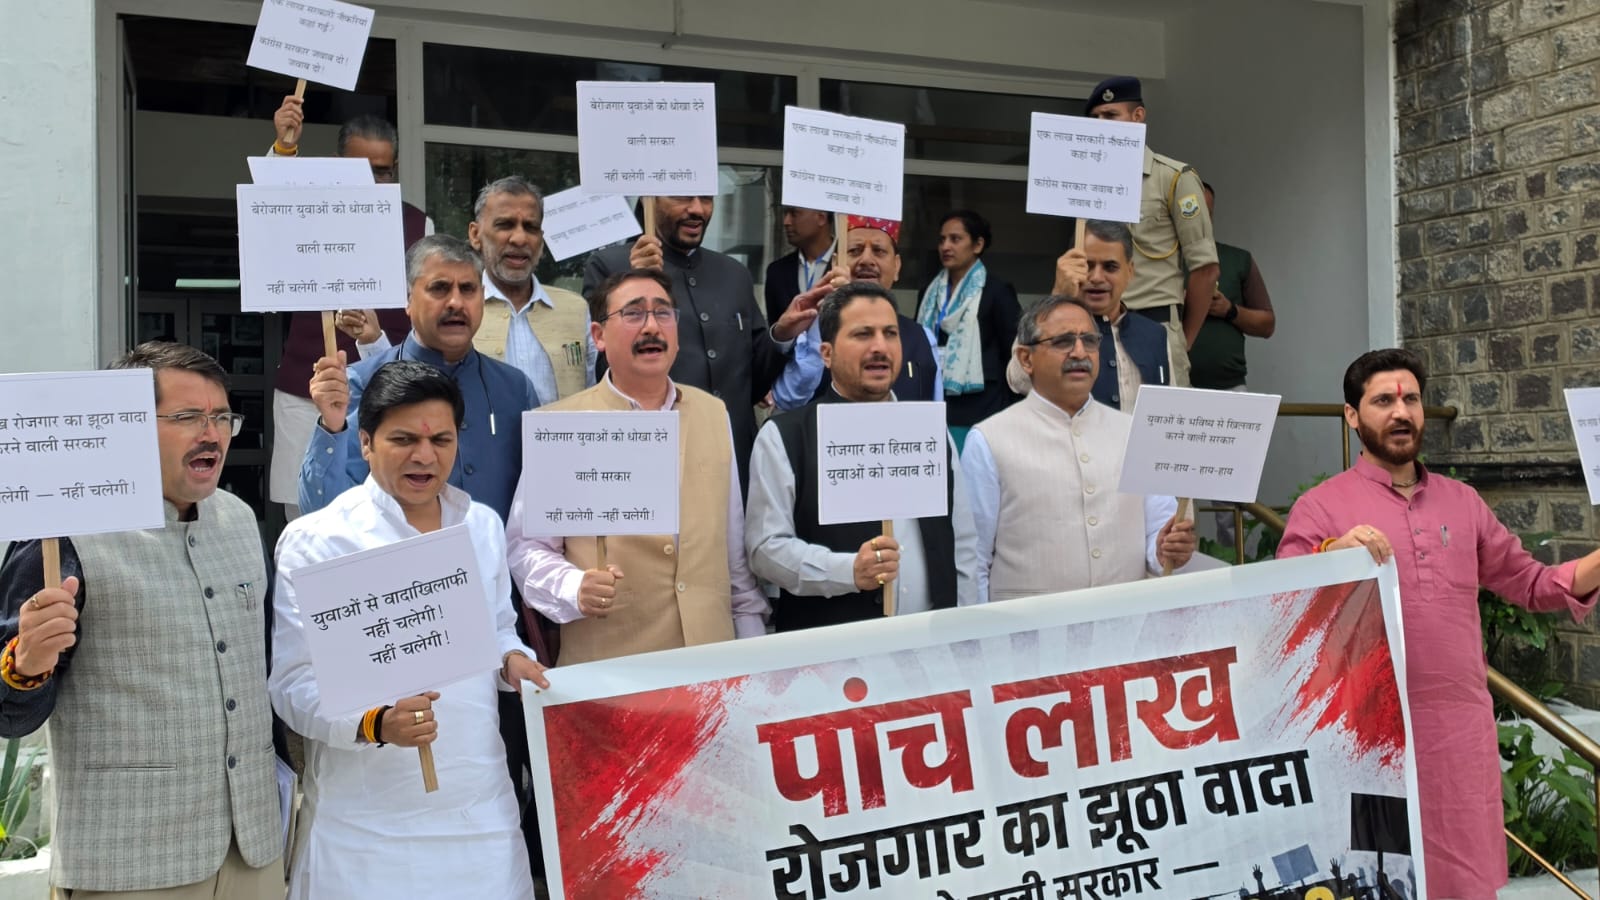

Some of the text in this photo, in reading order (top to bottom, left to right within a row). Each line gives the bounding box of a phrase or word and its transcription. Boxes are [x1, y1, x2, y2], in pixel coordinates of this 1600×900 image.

[285, 42, 310, 56] सरकार
[590, 97, 705, 114] बेरोजगार युवाओं को धोखा देने
[627, 134, 675, 146] वाली सरकार
[792, 122, 807, 133] एक
[809, 125, 830, 137] लाख
[832, 129, 863, 142] सरकारी
[1037, 129, 1051, 141] एक
[1054, 131, 1073, 142] लाख
[1075, 132, 1105, 146] सरकारी
[1071, 149, 1088, 161] कहां
[604, 169, 618, 182] नहीं
[621, 169, 645, 181] चलेगी
[789, 169, 815, 182] कांग्रेस
[817, 174, 846, 186] सरकार
[1034, 176, 1059, 190] कांग्रेस
[1061, 180, 1088, 192] सरकार
[1091, 185, 1113, 196] जवाब
[251, 200, 391, 218] बेरोजगार युवाओं को धोखा देने
[1068, 197, 1091, 208] जवाब
[296, 240, 356, 254] वाली सरकार
[266, 280, 285, 295] नहीं
[287, 278, 318, 293] चलेगी
[347, 278, 382, 292] चलेगी!
[12, 413, 59, 430] रोजगार
[63, 415, 83, 427] का
[86, 412, 115, 430] झूठा
[117, 411, 148, 424] वादा
[1147, 413, 1174, 427] युवाओं
[1176, 413, 1186, 426] के
[1189, 415, 1215, 428] भविष्य
[1217, 417, 1225, 429] से
[25, 435, 59, 452] वाली
[62, 436, 107, 451] सरकार
[534, 428, 668, 446] बेरोजगार युवाओं को धोखा देने
[1165, 430, 1236, 446] करने वाली सरकार
[826, 437, 938, 457] रोजगार का हिसाब दो
[575, 468, 632, 482] वाली सरकार
[826, 460, 942, 486] युवाओं को जवाब दो!
[1154, 462, 1189, 473] हाय-हाय
[1199, 465, 1234, 476] हाय-हाय
[0, 486, 30, 504] लेगी
[59, 481, 85, 501] नहीं
[88, 478, 136, 497] चलेगी!
[545, 508, 563, 523] नहीं
[565, 508, 594, 521] चलेगी
[622, 508, 655, 521] चलेगी!
[311, 568, 468, 630] युवाओं से वादाखिलाफी
[362, 605, 443, 639] नहीं चलेगी!
[369, 630, 450, 665] नहीं चलेगी!
[756, 646, 1240, 818] पांच लाख
[766, 749, 1315, 900] रोजगार का झूठा वादा
[1053, 857, 1162, 900] सरकार
